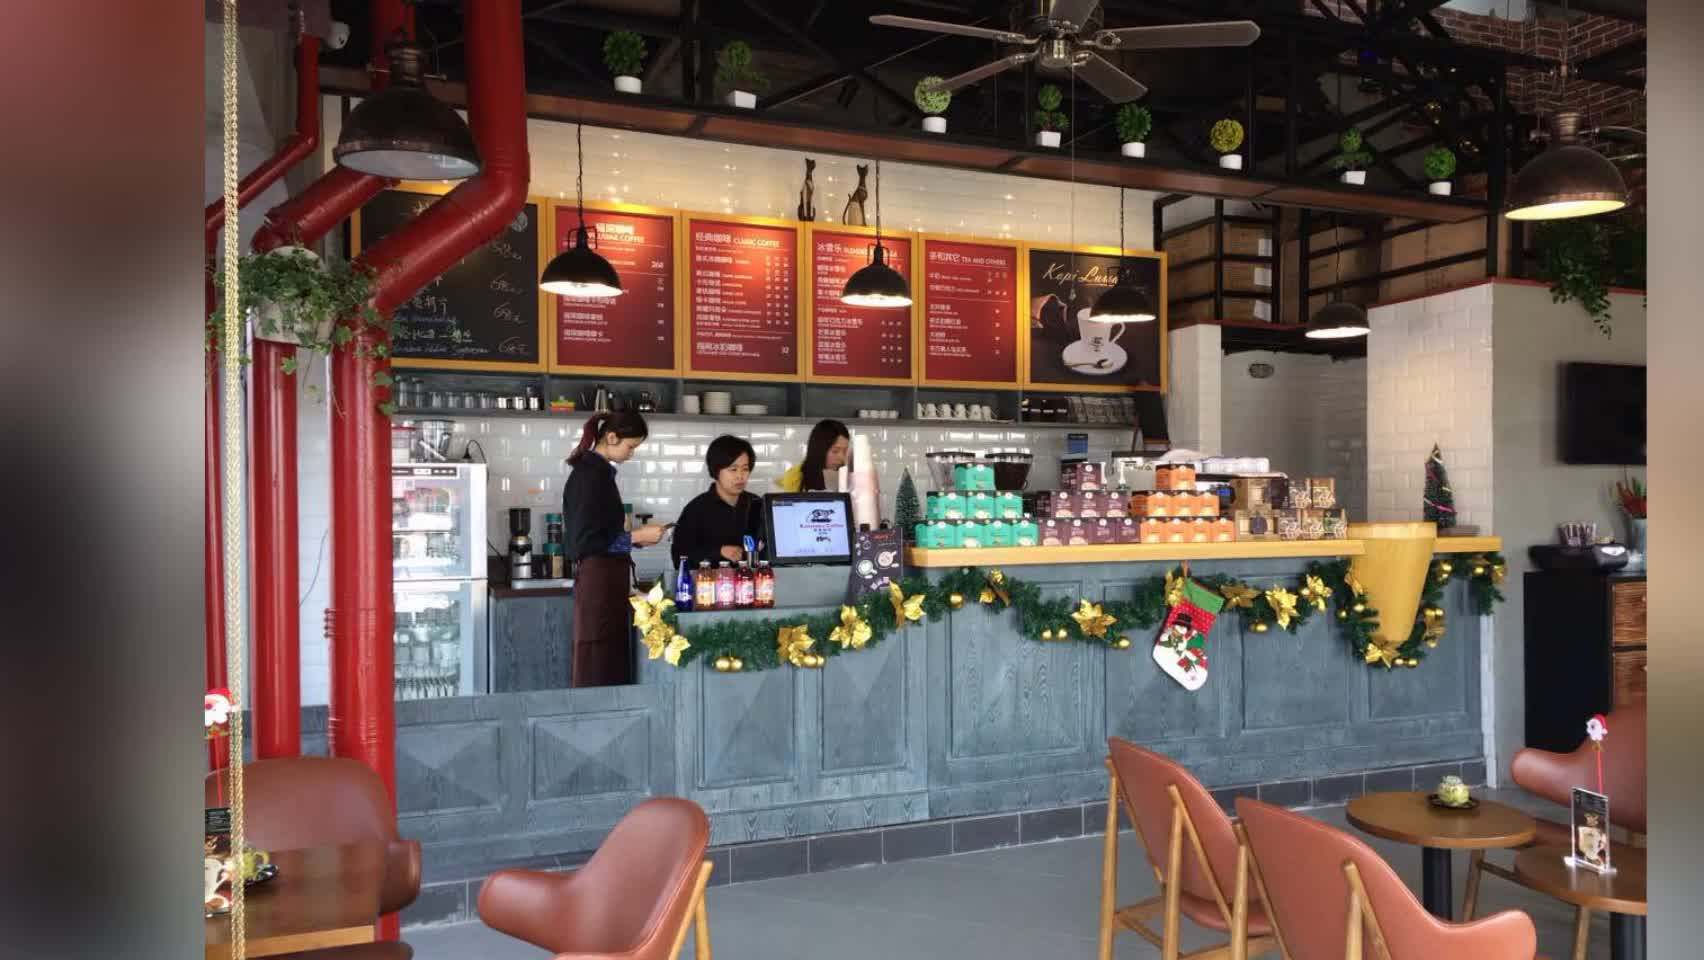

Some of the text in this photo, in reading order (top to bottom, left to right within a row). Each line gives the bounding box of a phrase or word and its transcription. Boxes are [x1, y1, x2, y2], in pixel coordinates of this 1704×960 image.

[696, 232, 780, 248] 经典咖啡 CLASSIC COFFEE
[817, 242, 841, 253] 冰雪乐
[929, 251, 1006, 266] 茶和其它 TEA AND OTHERS
